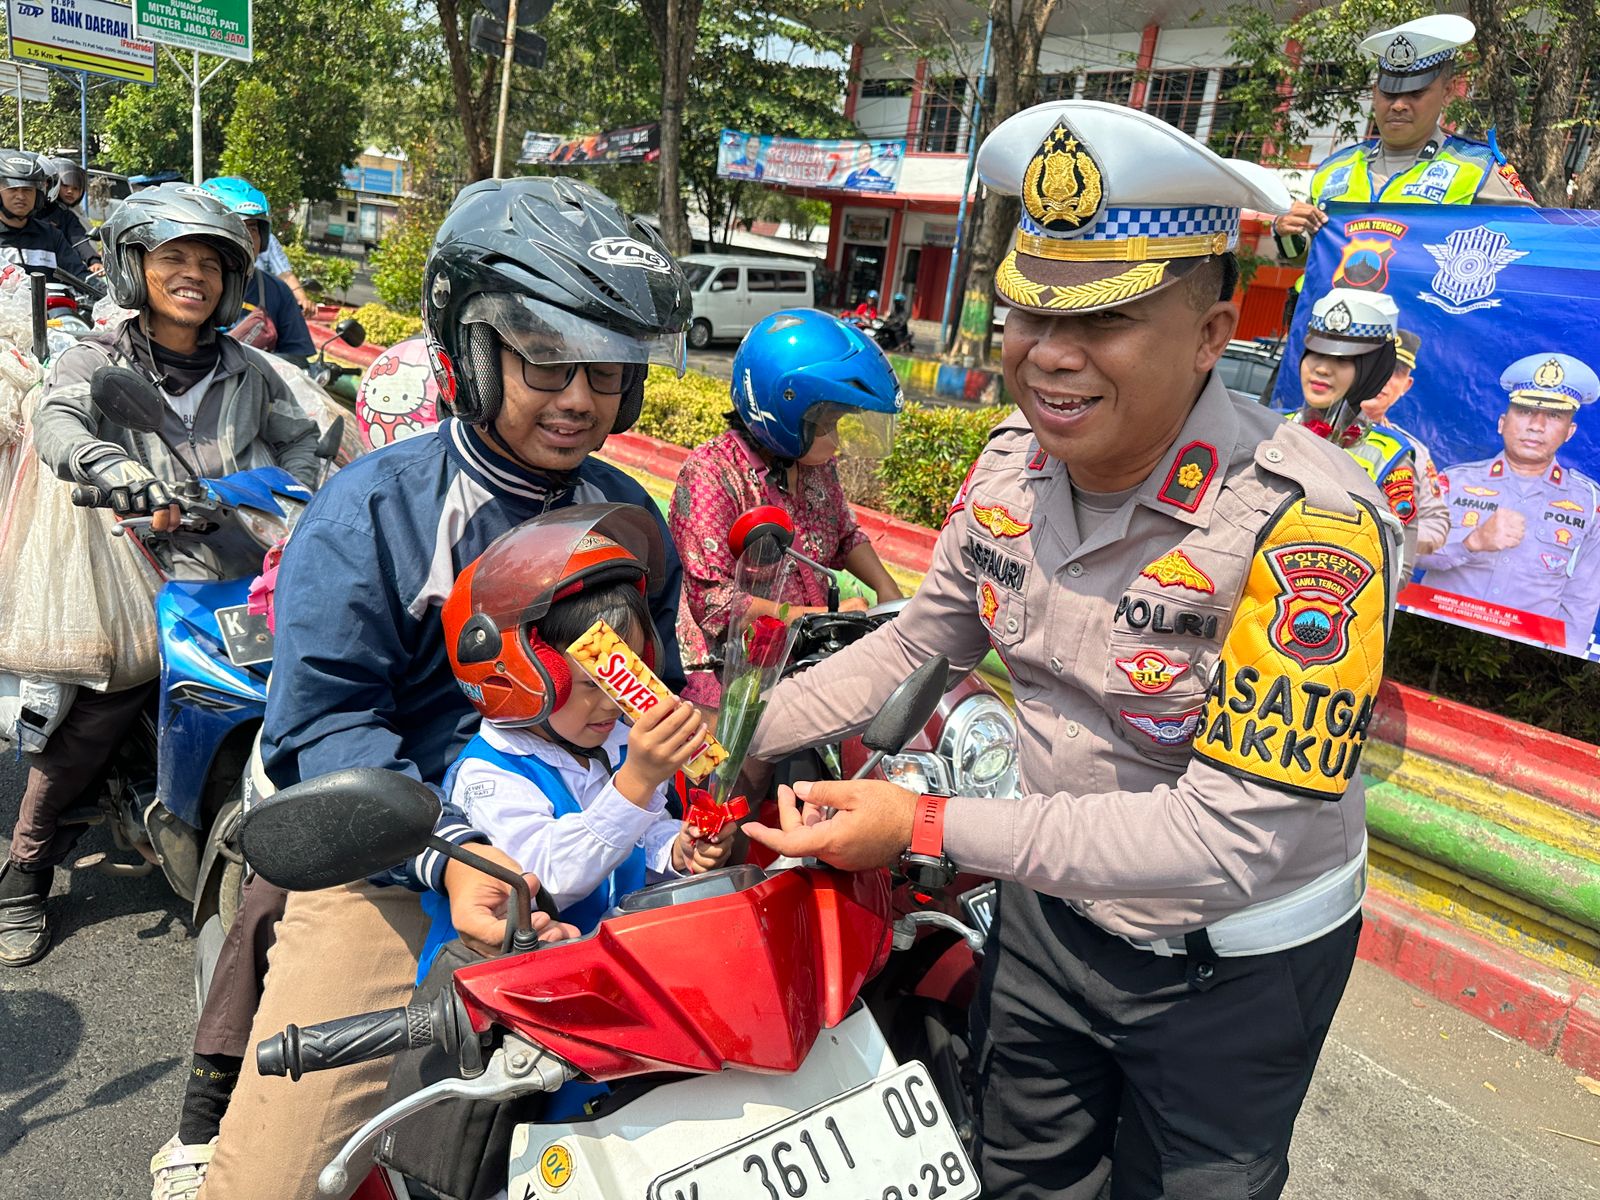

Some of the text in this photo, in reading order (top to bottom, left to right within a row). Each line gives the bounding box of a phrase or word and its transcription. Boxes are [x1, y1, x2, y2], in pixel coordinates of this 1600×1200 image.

[18, 4, 44, 18] BDP
[148, 2, 239, 31] MITRA BANGSA PATI
[197, 5, 218, 17] SAKIT
[51, 6, 83, 29] BANK
[85, 14, 128, 39] DAERAH
[142, 12, 181, 31] DOKTER
[183, 22, 208, 36] JAGA
[210, 27, 223, 40] 24
[225, 31, 245, 45] JAM
[27, 48, 54, 60] 1,5 Km
[764, 162, 829, 182] INDONESIA
[1403, 185, 1444, 202] POLISI
[1349, 220, 1404, 236] JAWA TENGAH
[1453, 497, 1499, 512] ASFAURI
[1543, 511, 1586, 530] POLRI
[1283, 552, 1362, 578] POLRESTA
[1300, 560, 1348, 576] PATI
[1295, 577, 1346, 596] JAWA TENGAH
[224, 611, 246, 636] K
[1113, 595, 1218, 639] POLRI
[597, 653, 659, 713] SILVER
[1132, 671, 1171, 684] ETLE
[546, 1152, 566, 1180] OK
[743, 1116, 856, 1200] 3611
